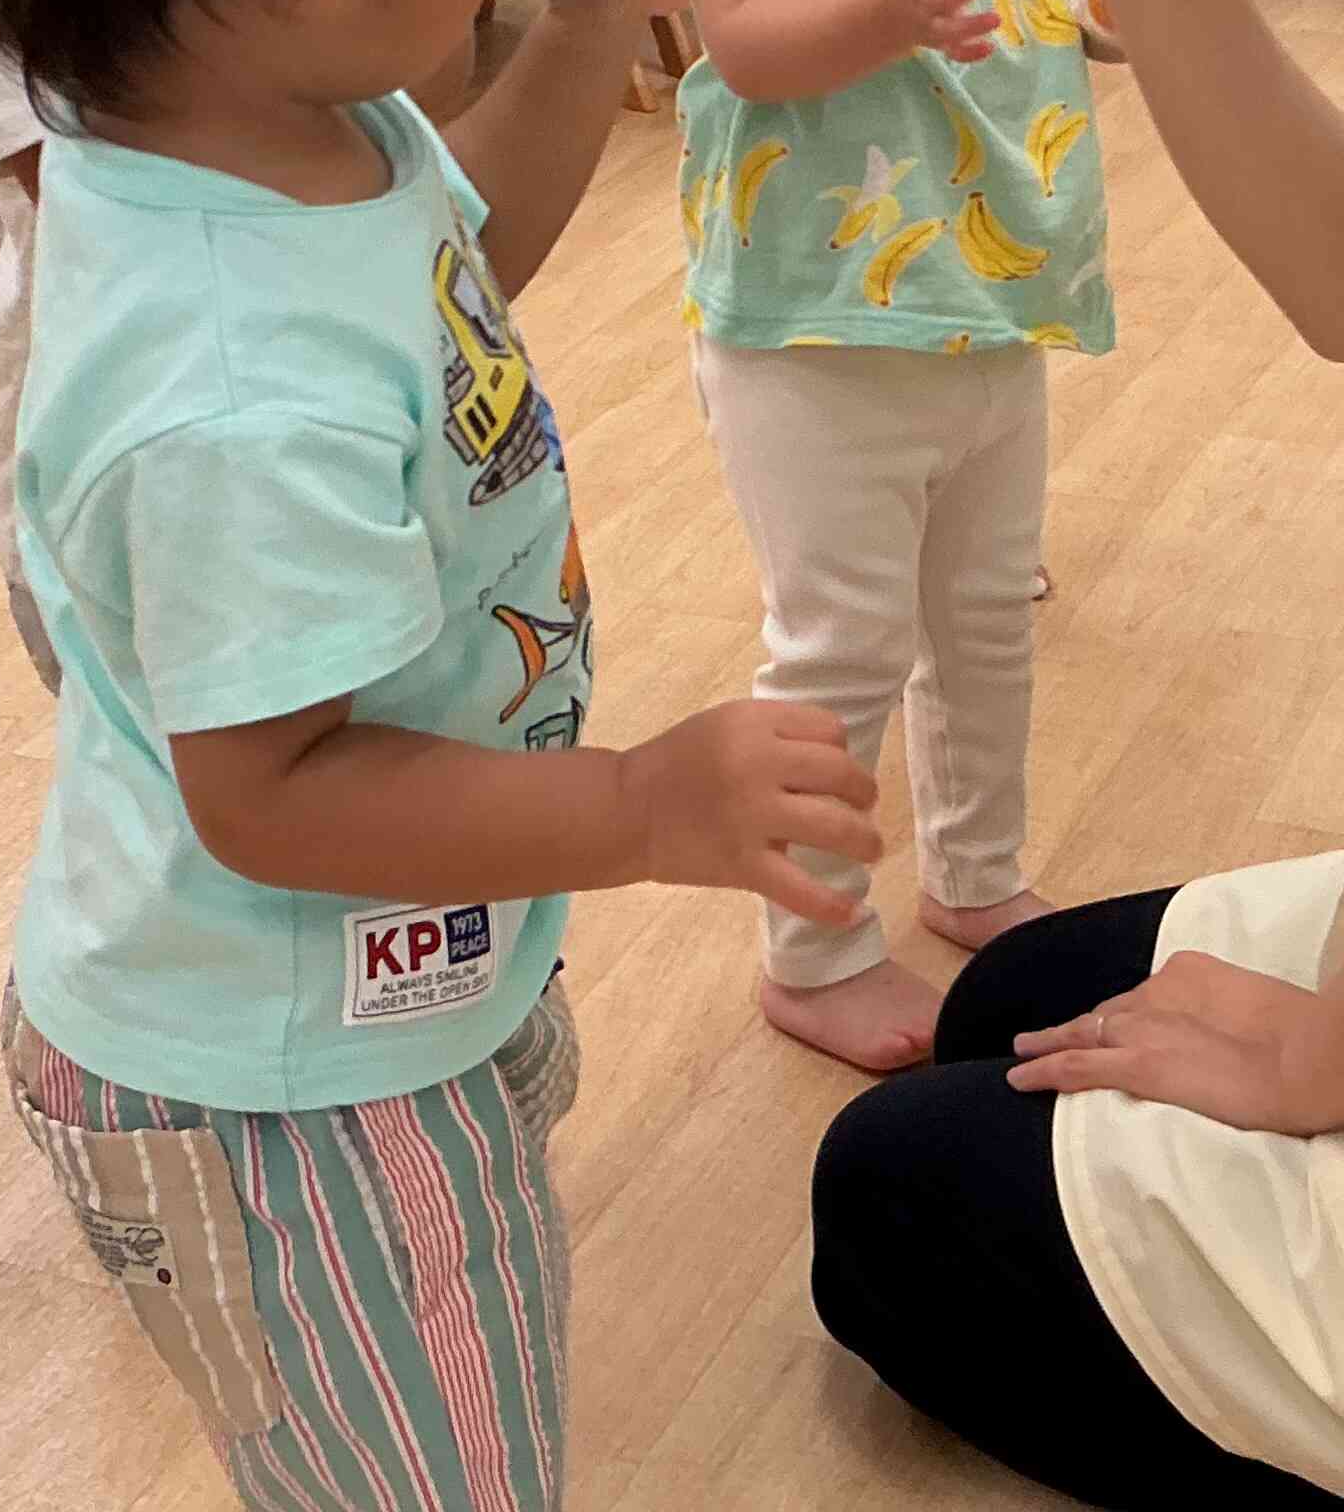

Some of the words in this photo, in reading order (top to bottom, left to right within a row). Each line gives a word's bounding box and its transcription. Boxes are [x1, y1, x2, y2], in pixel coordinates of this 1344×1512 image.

[452, 912, 482, 936] 1973
[366, 920, 442, 980] KP
[449, 933, 489, 957] PEACE
[361, 993, 408, 1012] UNDER
[411, 988, 436, 1004] THE
[439, 979, 470, 999] OPEN
[380, 973, 433, 995] ALWAYS
